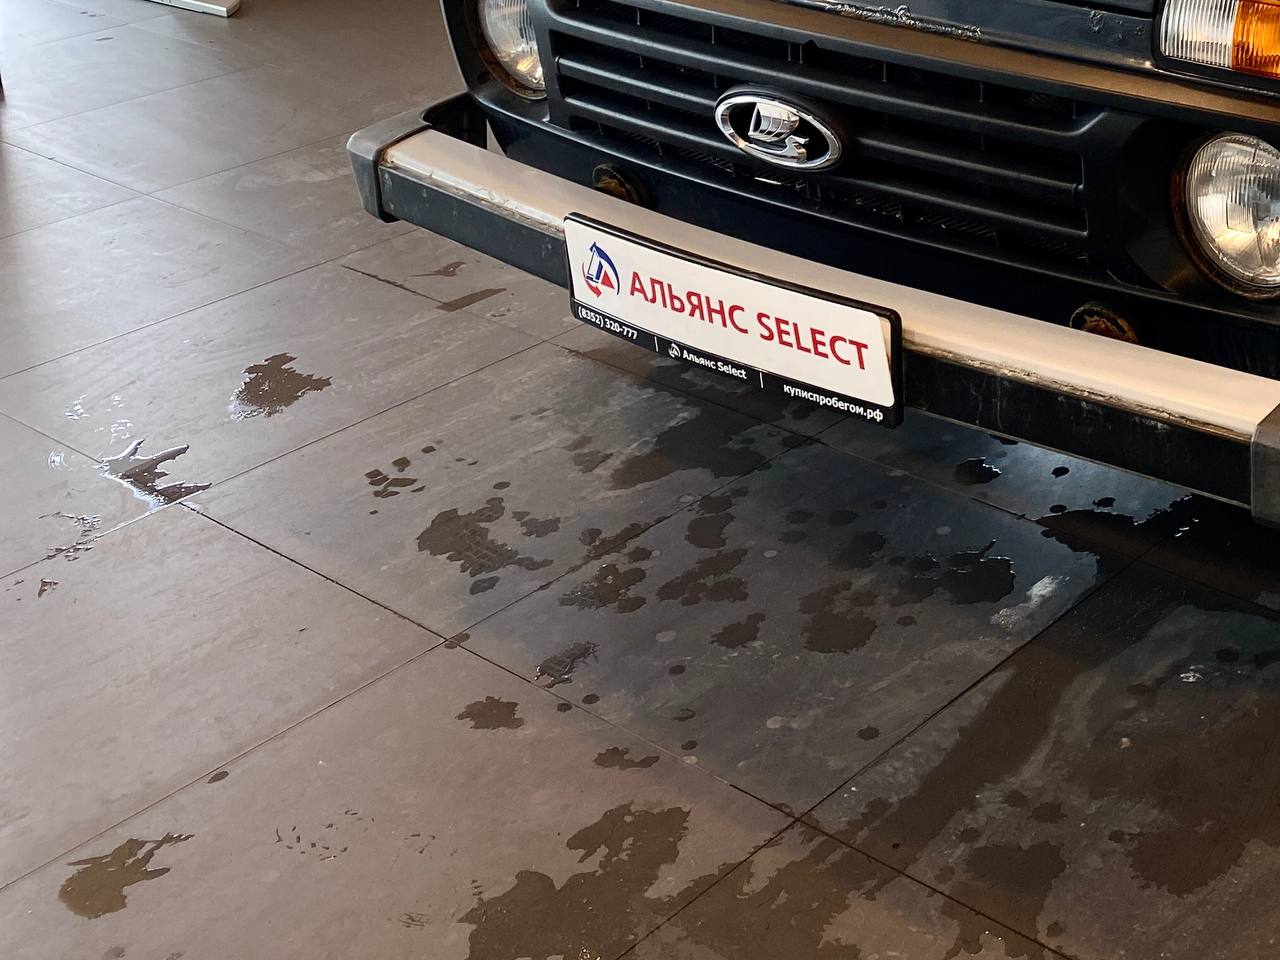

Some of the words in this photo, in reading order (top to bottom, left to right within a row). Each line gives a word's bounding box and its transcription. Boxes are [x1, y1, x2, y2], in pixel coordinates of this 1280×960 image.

[578, 306, 604, 327] (8352)
[605, 318, 638, 340] 320-777
[630, 272, 748, 334] АЛЬЯНС
[756, 313, 868, 370] SELECT
[682, 349, 716, 369] Альянс
[717, 361, 748, 380] Select
[783, 384, 884, 422] куписпробегом.рф
